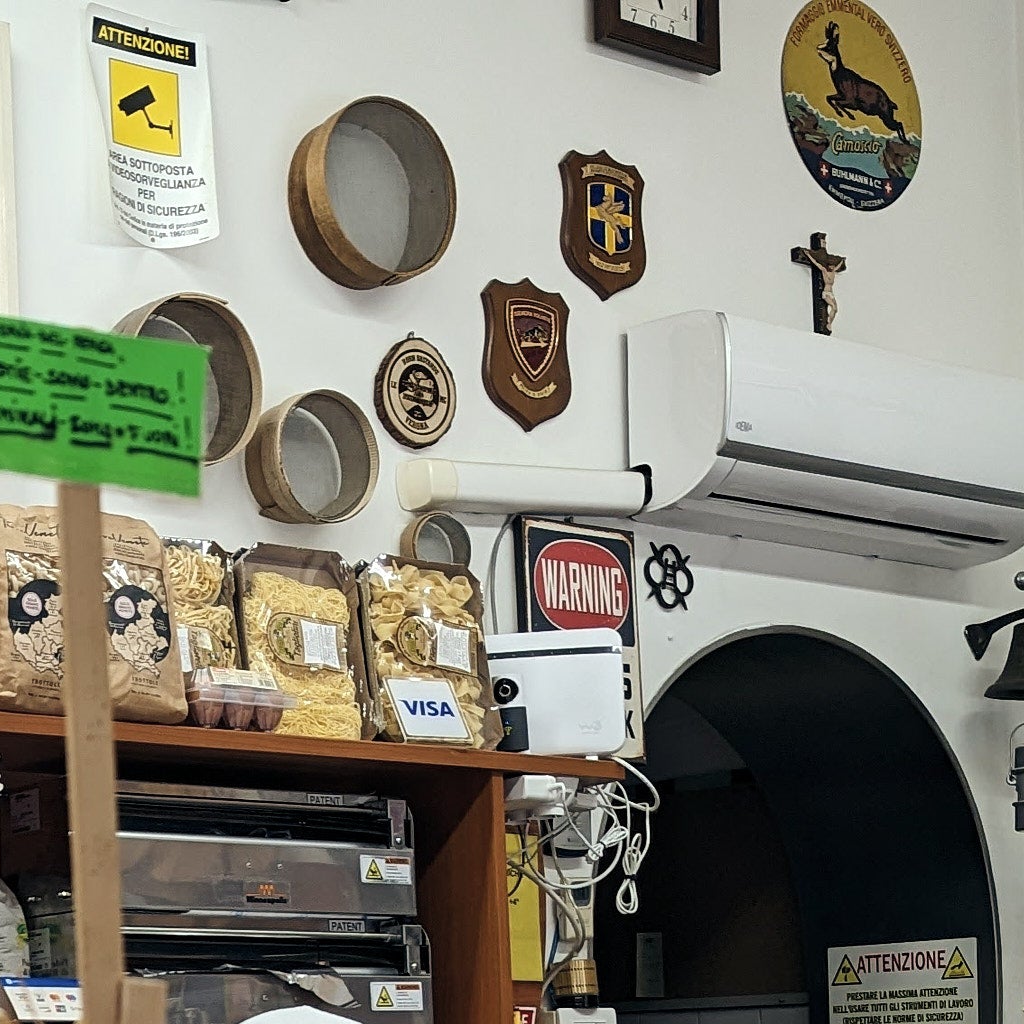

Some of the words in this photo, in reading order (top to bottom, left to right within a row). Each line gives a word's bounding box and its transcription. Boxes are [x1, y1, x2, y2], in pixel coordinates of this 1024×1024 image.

[631, 9, 637, 21] 7
[650, 14, 657, 29] 6
[668, 21, 675, 34] 5
[681, 6, 688, 21] 4
[97, 24, 190, 61] ATTENZIONE!
[129, 157, 195, 176] SOTTOPOSTA
[137, 187, 156, 201] PER
[137, 201, 146, 212] DI
[146, 203, 206, 217] SICUREZZA
[541, 557, 624, 618] WARNING
[400, 700, 455, 718] VISA
[309, 795, 342, 804] PATENT
[331, 922, 363, 931] PATENT
[857, 950, 946, 974] ATTENZIONE
[847, 991, 878, 1001] PRESTARE
[879, 991, 887, 999] LA
[889, 990, 918, 999] MASSIMA
[920, 987, 958, 997] ATTENZIONE
[871, 1003, 887, 1012] TUTTI
[889, 1003, 900, 1011] GLI
[901, 1001, 937, 1011] STRUMENTI
[939, 1000, 947, 1008] DI
[948, 999, 973, 1008] LAVORO
[883, 1015, 891, 1024] LE
[892, 1014, 915, 1023] NORME
[917, 1014, 924, 1022] DI
